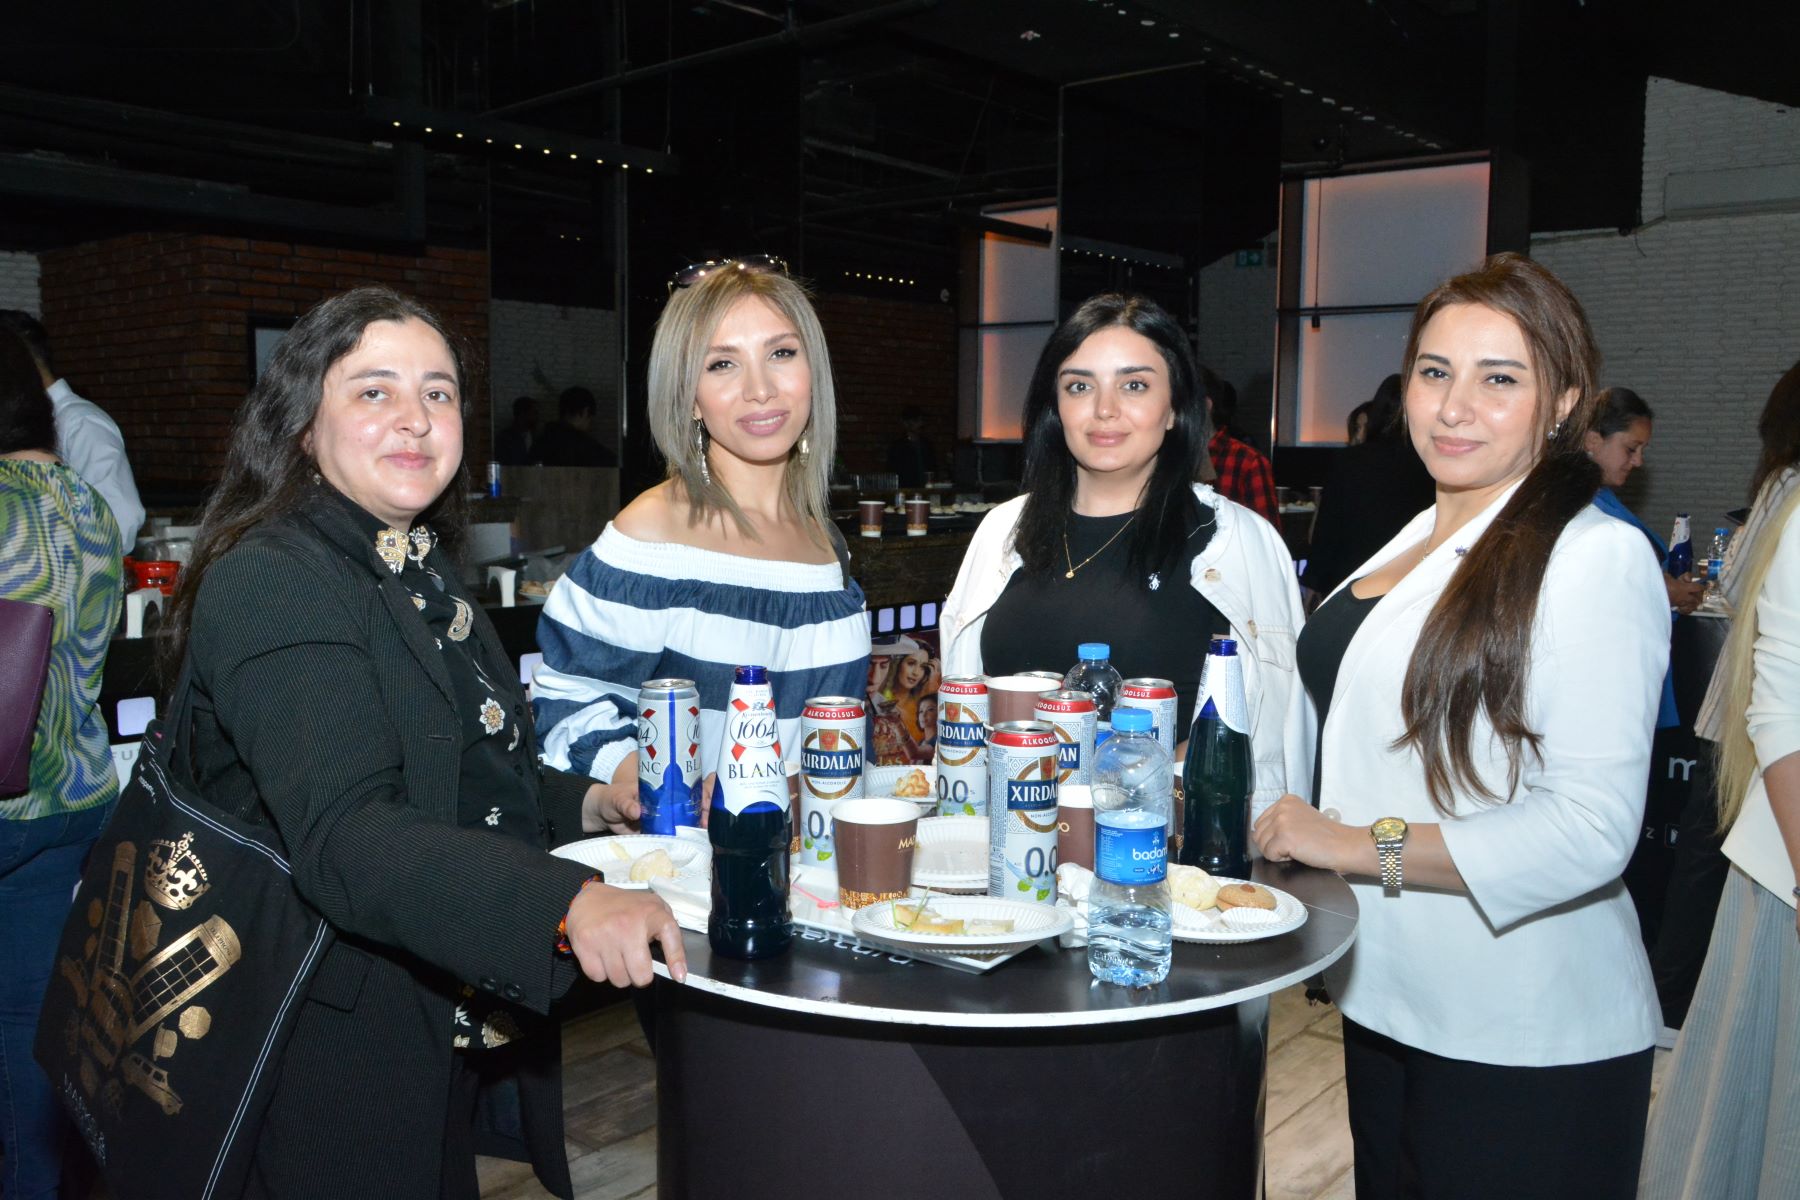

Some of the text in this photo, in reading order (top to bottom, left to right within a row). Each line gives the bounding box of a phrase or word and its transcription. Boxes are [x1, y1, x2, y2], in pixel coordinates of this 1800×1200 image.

[737, 718, 776, 740] 1664
[728, 760, 786, 779] BLANC
[801, 751, 861, 770] XIRDALAN
[807, 810, 836, 839] 0.
